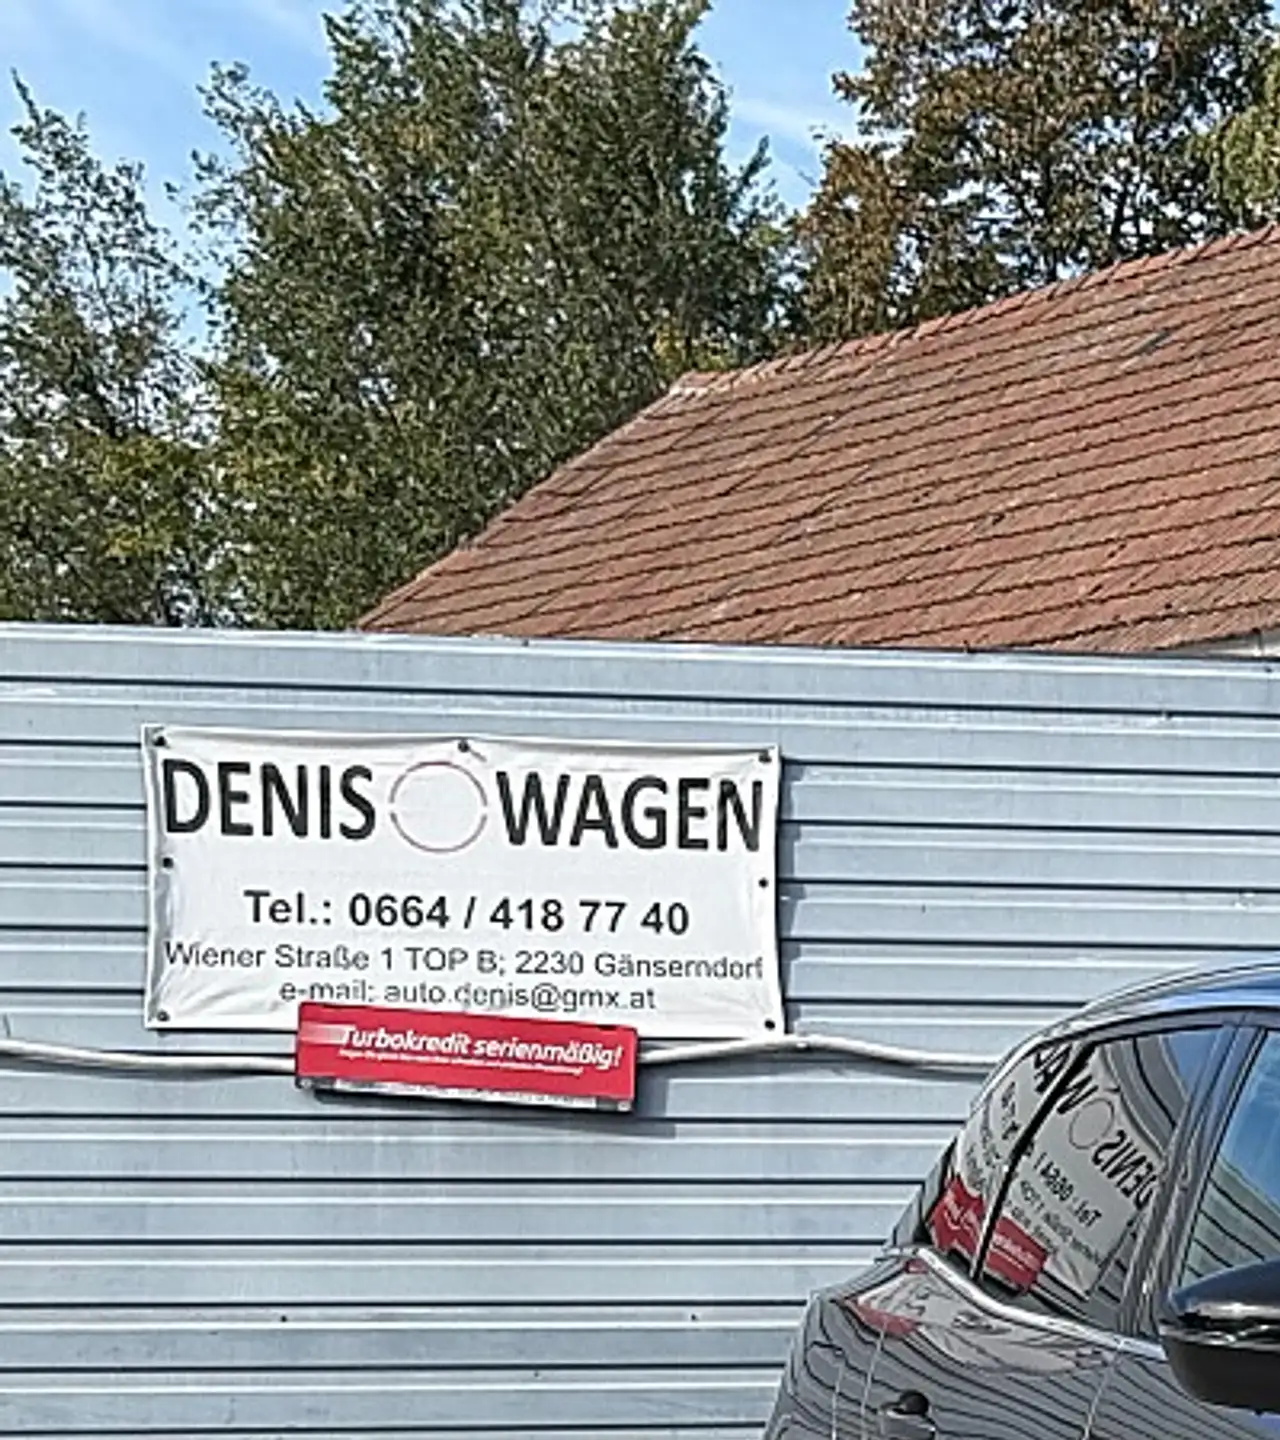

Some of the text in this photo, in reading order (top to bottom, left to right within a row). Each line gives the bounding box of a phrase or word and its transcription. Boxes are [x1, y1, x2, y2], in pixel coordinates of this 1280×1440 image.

[162, 758, 763, 852] DENIS WAGEN
[244, 889, 690, 935] Tel.: 0664 / 418 77 40
[165, 940, 266, 968] Wiener
[275, 943, 370, 970] Straße
[382, 947, 393, 970] 1
[404, 947, 468, 971] TOP
[515, 950, 585, 975] 2230
[594, 952, 764, 979] Gänserndorf
[384, 980, 656, 1012] auto.denis@gmx.at
[339, 1024, 470, 1056] Turbokredit
[474, 1036, 624, 1071] serienmäßig!
